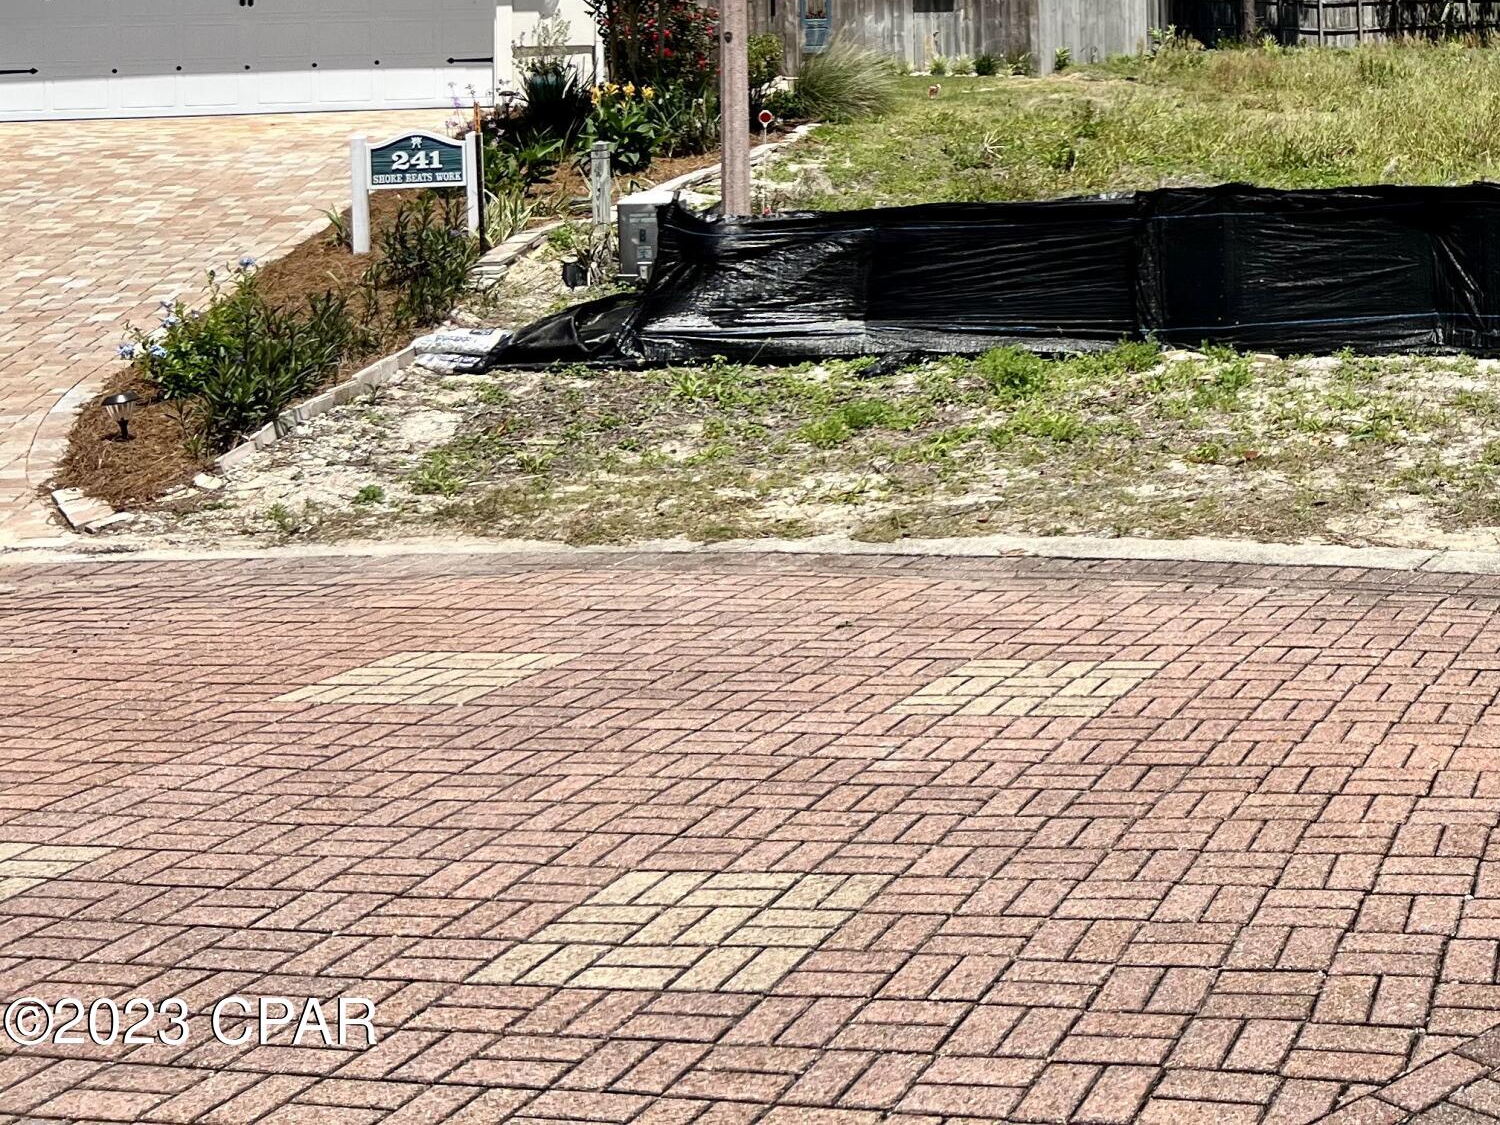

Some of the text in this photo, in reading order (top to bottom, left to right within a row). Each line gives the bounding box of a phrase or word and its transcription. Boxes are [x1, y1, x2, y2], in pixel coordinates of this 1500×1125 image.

[391, 150, 443, 170] 241
[372, 172, 462, 183] SHORE BEATS WORK
